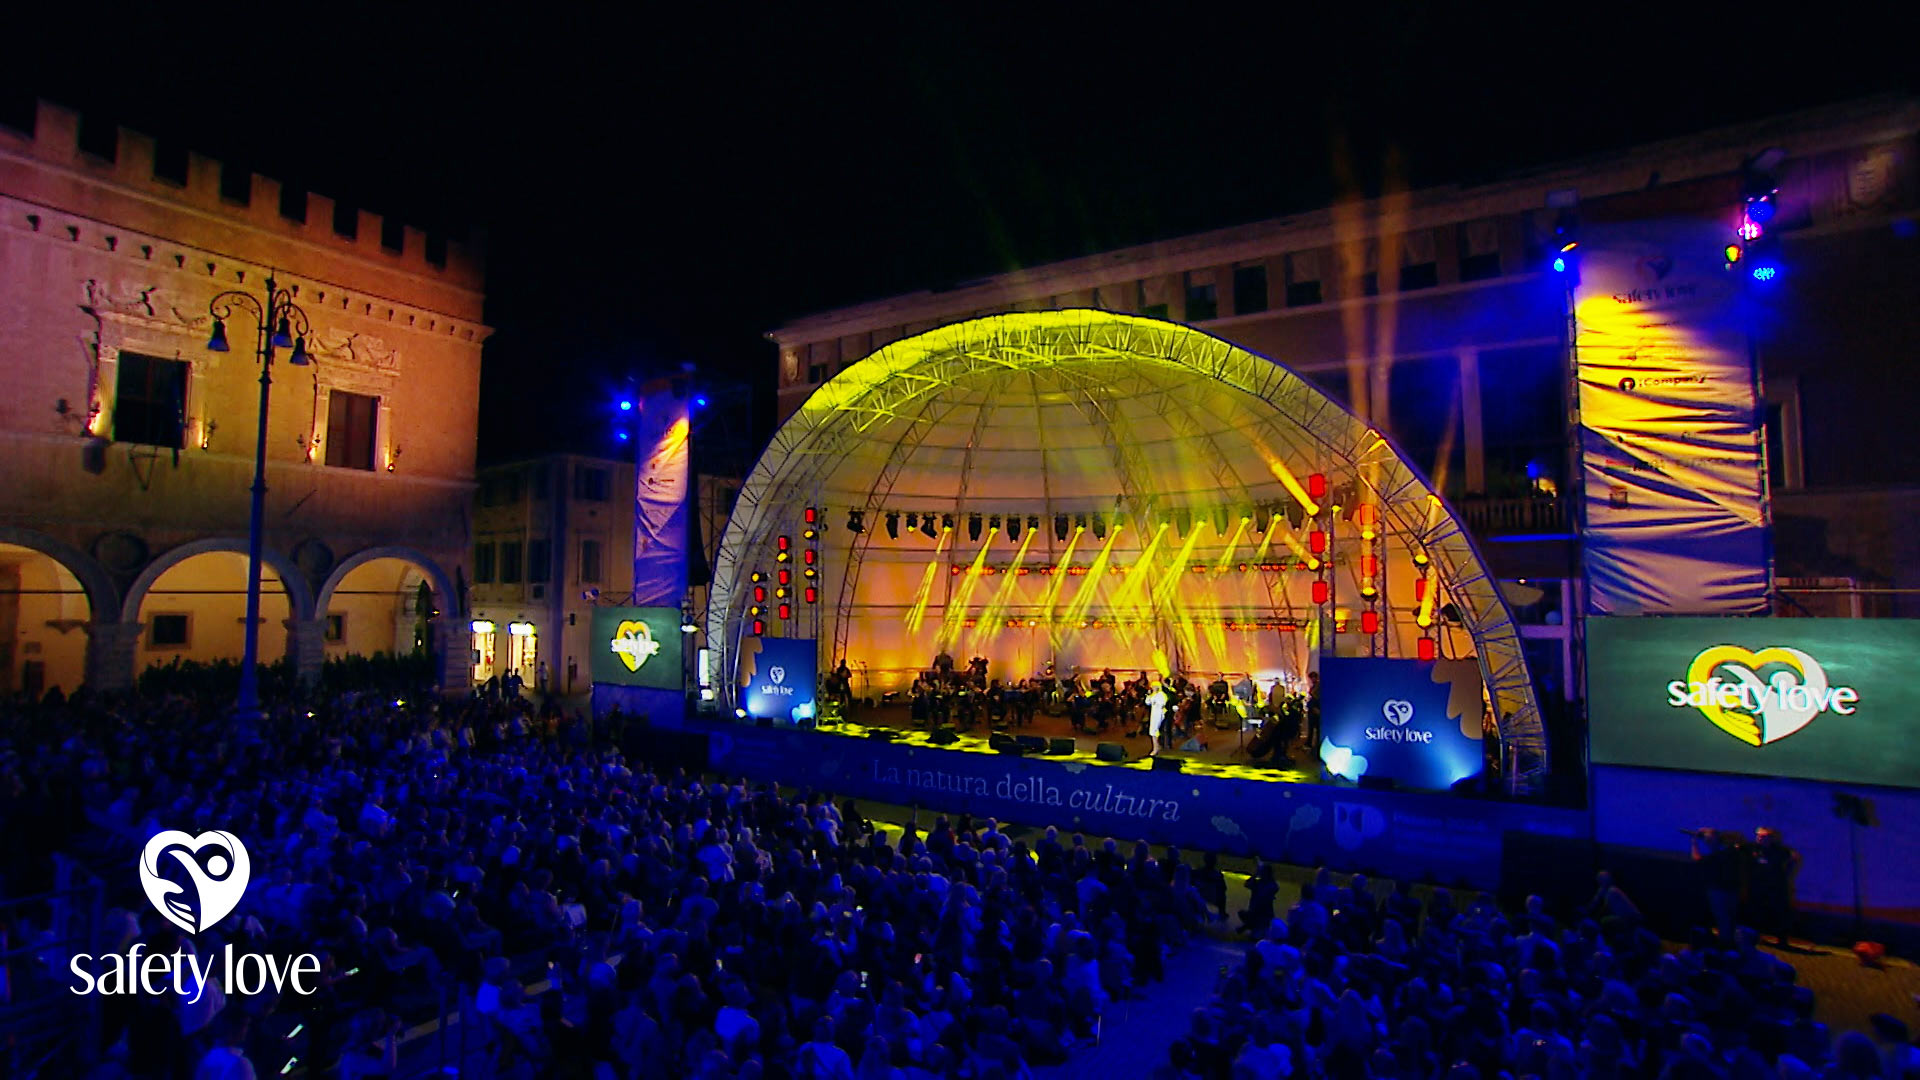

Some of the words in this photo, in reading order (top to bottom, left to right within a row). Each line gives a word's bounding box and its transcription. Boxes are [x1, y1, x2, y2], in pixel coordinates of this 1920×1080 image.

[1667, 677, 1772, 714] safety
[1778, 679, 1860, 715] love
[1365, 726, 1404, 744] safety
[1406, 727, 1433, 744] love
[872, 759, 902, 784] La
[906, 769, 990, 798] natura
[996, 773, 1063, 807] della
[1069, 785, 1181, 823] cultura
